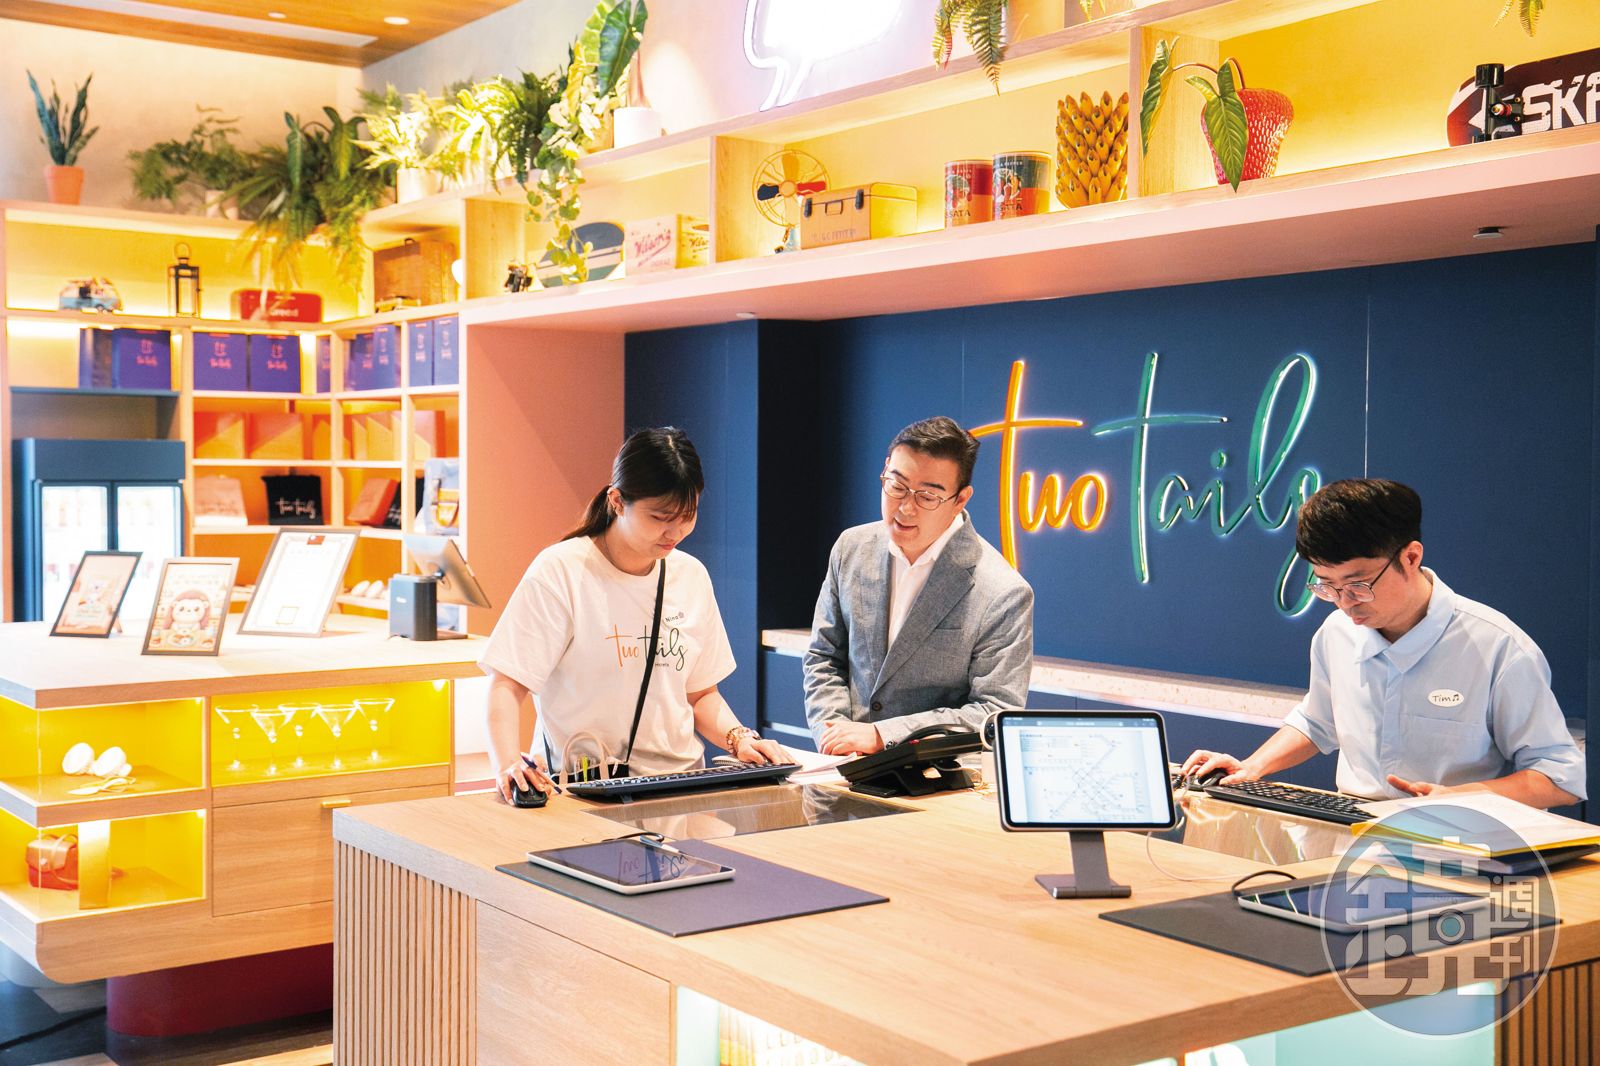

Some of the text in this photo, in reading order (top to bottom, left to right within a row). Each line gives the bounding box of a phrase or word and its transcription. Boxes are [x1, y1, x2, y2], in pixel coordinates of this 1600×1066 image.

[970, 360, 1109, 570] tuo
[605, 624, 688, 671] tuo tils
[1432, 694, 1452, 703] Tim
